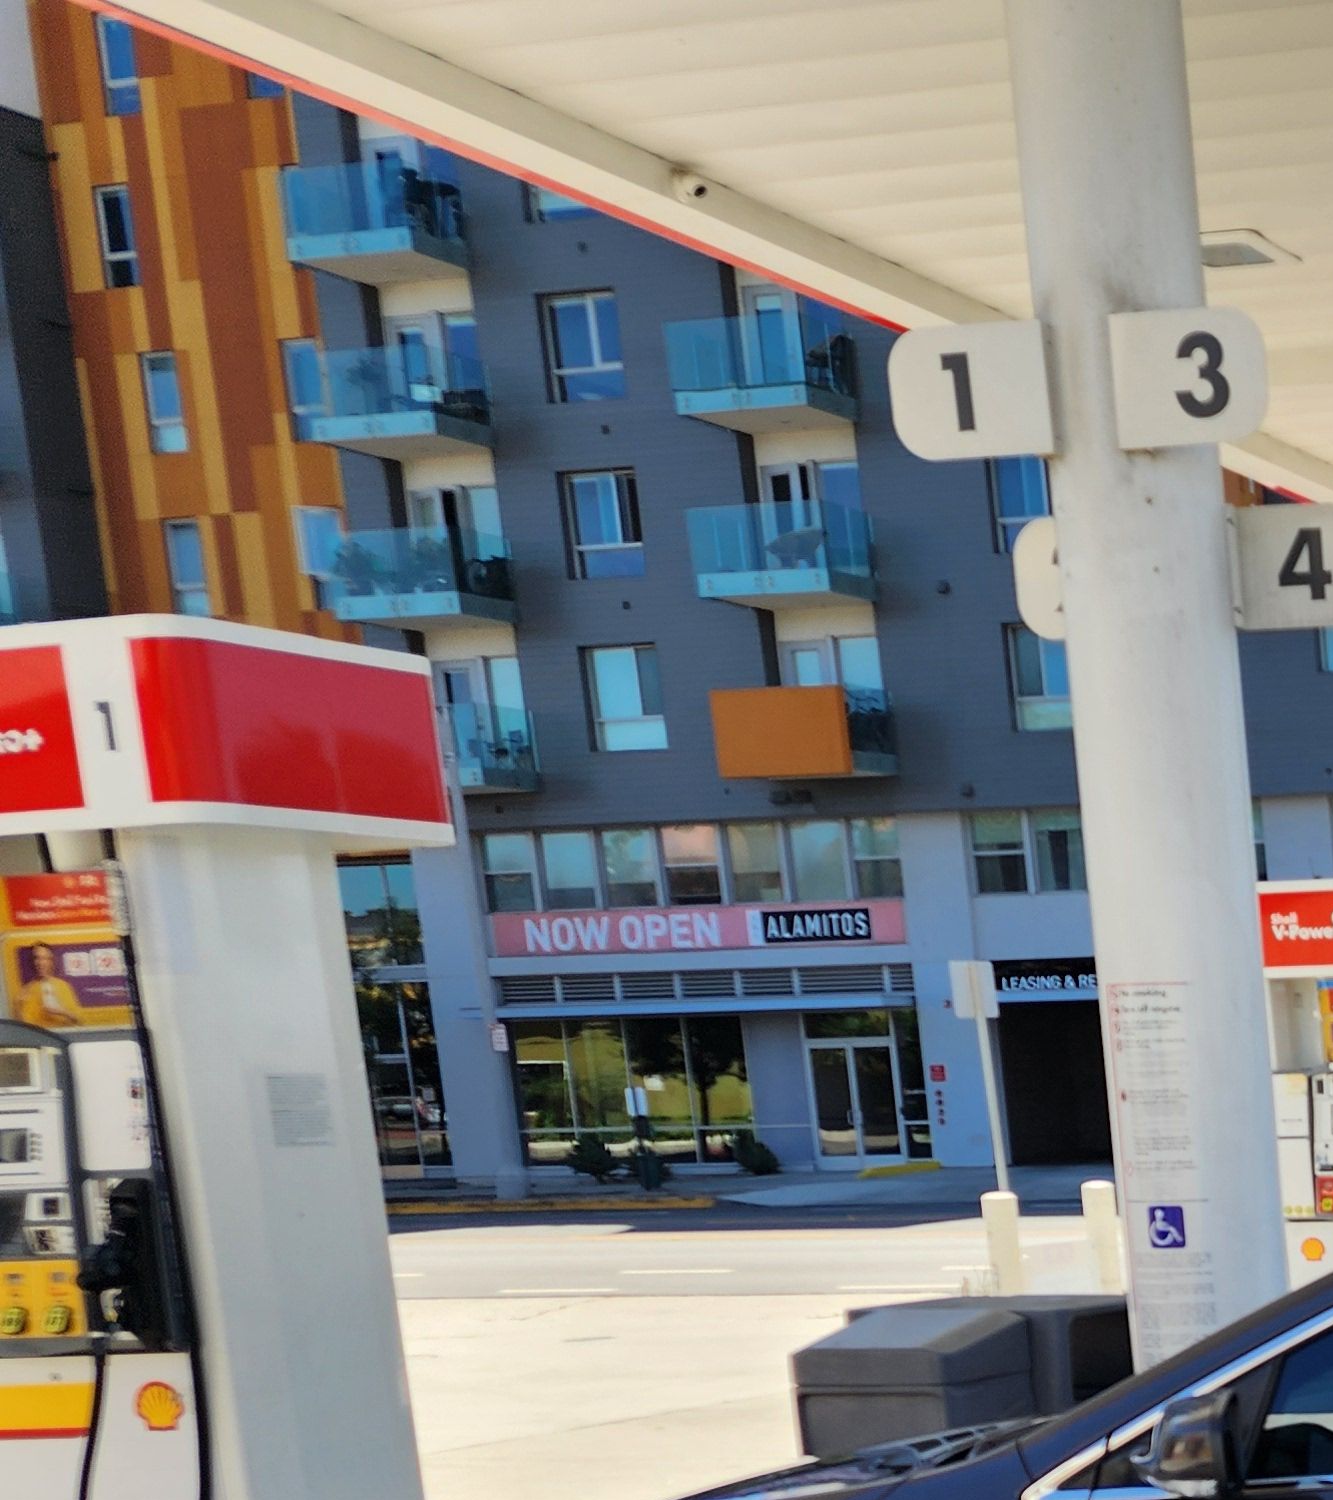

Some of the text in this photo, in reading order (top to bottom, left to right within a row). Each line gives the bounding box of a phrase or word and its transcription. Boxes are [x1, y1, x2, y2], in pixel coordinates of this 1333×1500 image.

[939, 351, 976, 432] 1
[1174, 330, 1231, 419] 3
[1278, 527, 1333, 601] 4
[96, 701, 117, 752] 1
[523, 911, 723, 953] NOW OPEN
[766, 909, 870, 939] ALAMITOS
[1270, 911, 1299, 925] Shell
[1001, 973, 1097, 991] LEASING & RE
